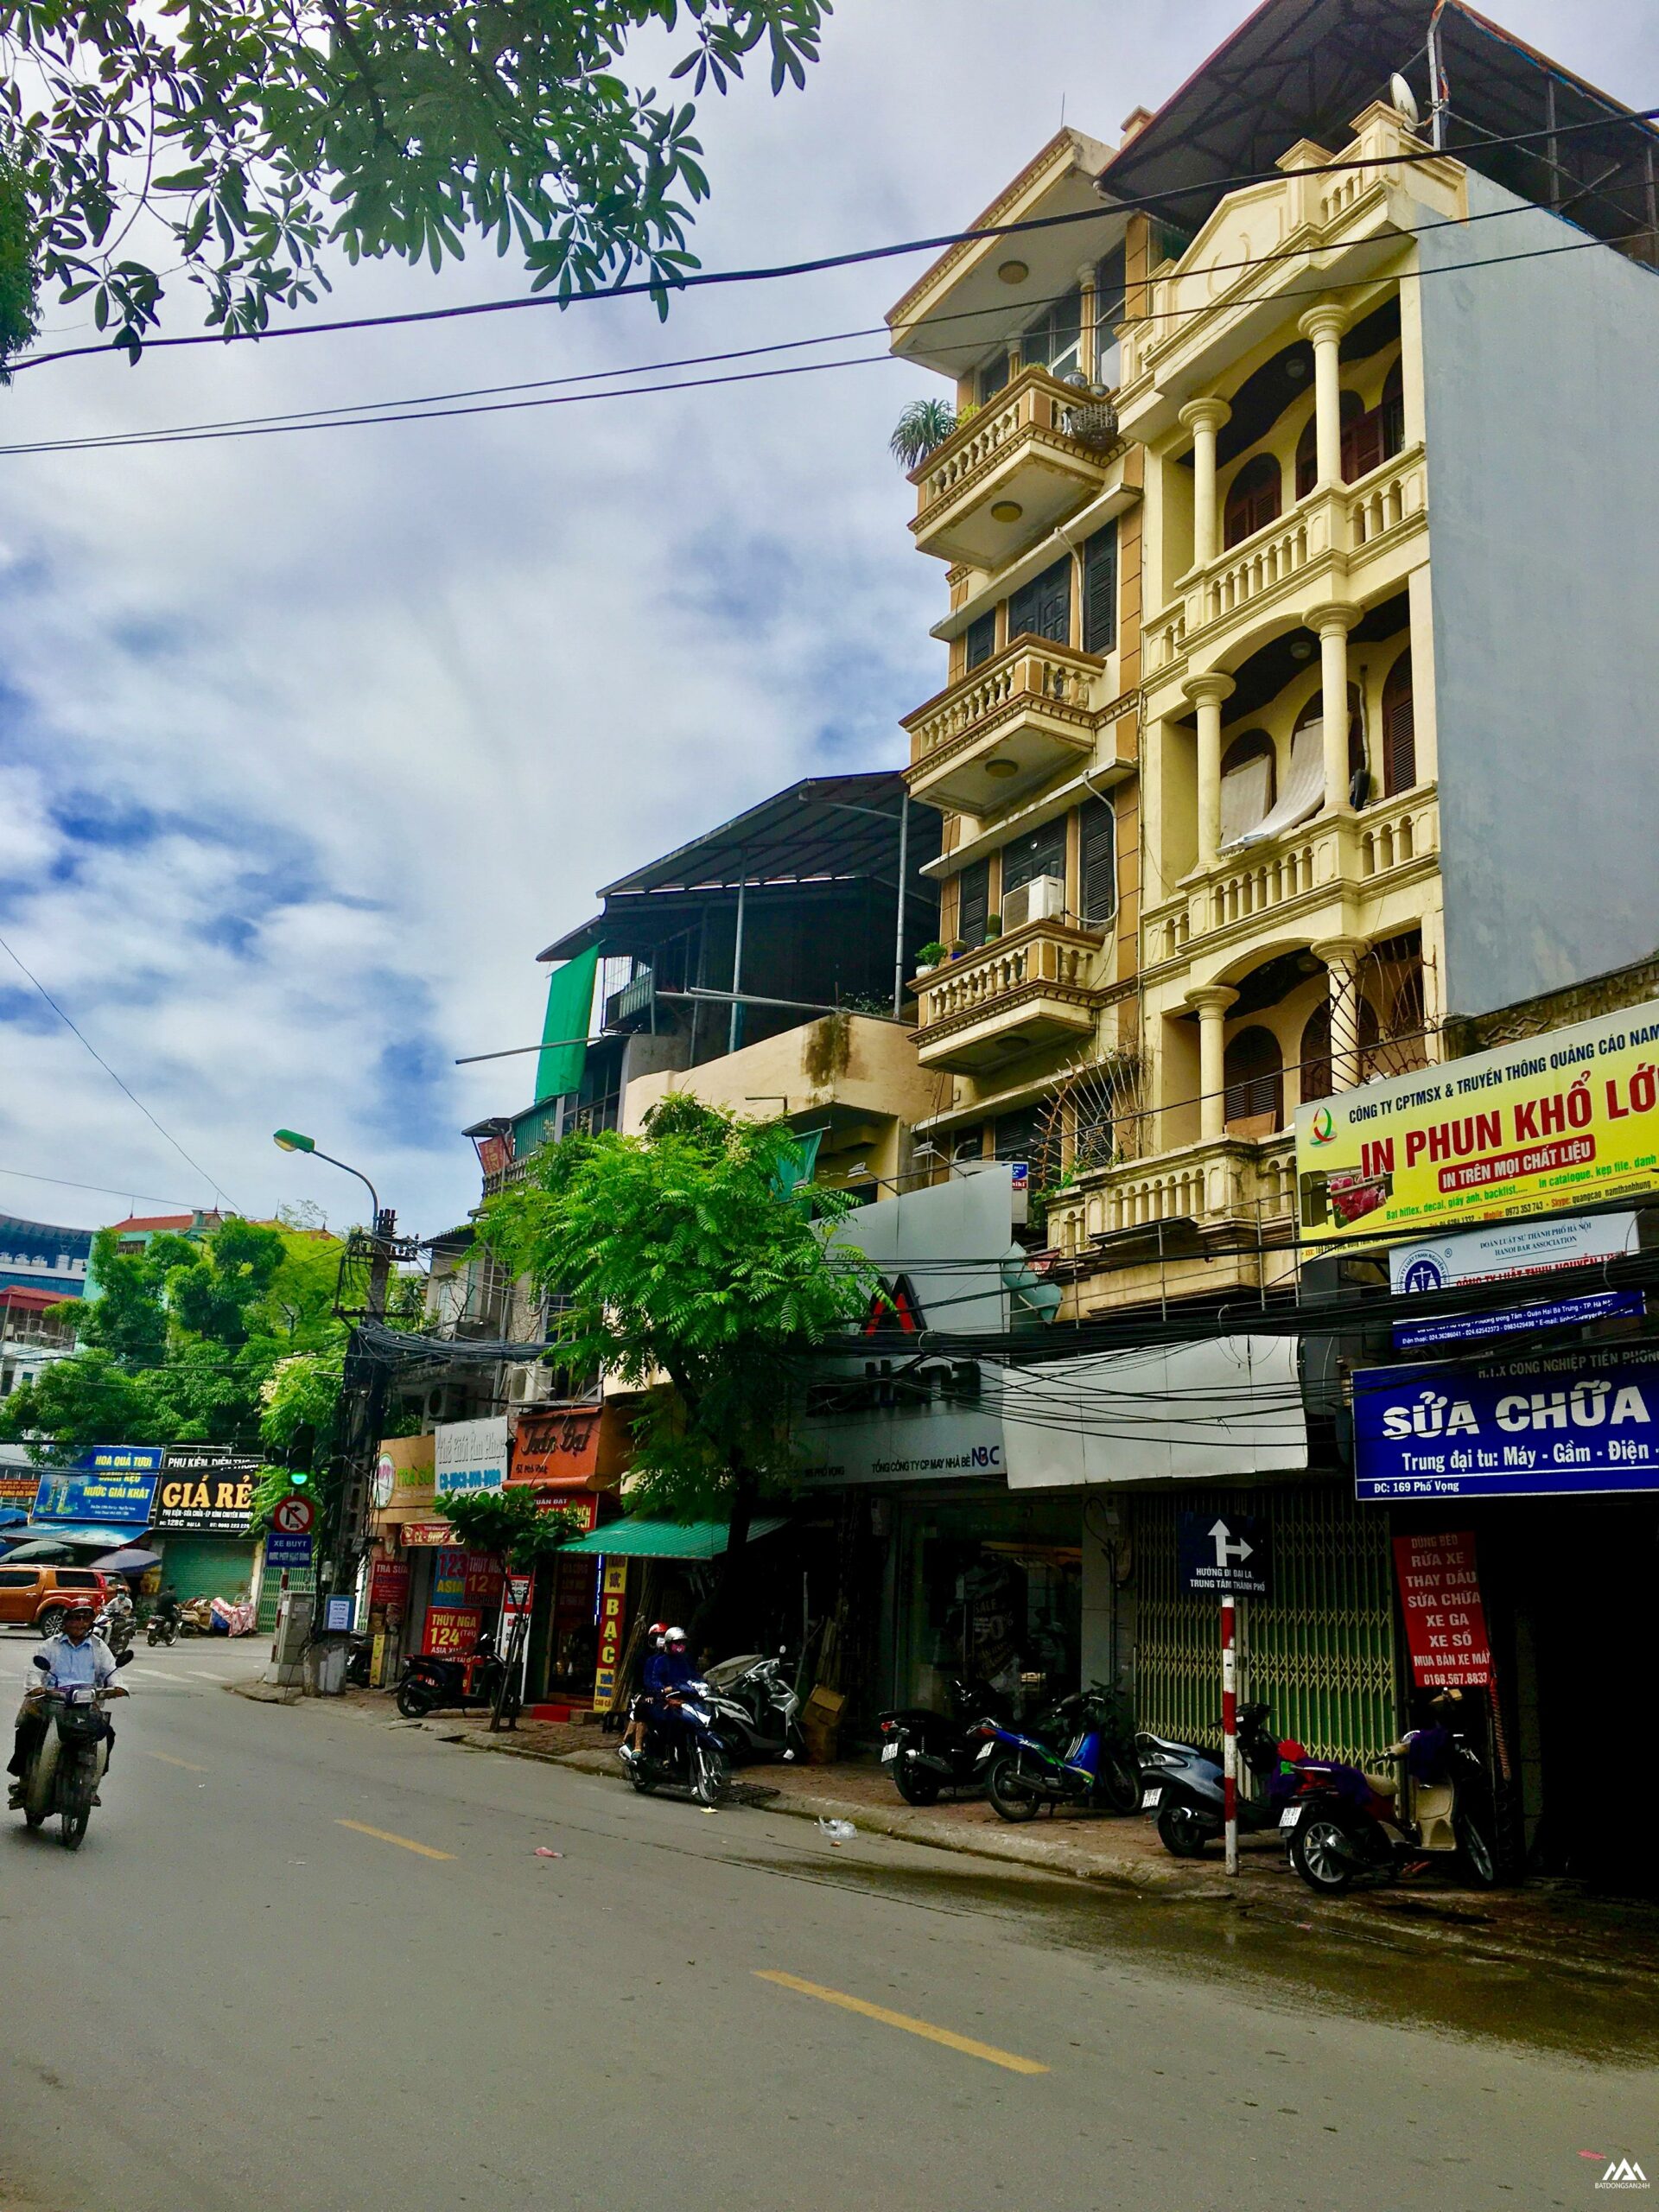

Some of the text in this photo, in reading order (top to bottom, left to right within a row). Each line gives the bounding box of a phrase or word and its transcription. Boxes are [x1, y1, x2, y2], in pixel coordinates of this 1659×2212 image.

[1349, 1104, 1377, 1123] CÔNG
[1380, 1100, 1392, 1115] TY
[1395, 1086, 1441, 1111] CPTMSX
[1445, 1084, 1453, 1097] &
[1505, 1057, 1546, 1080] THÔNG
[1550, 1043, 1594, 1070] QUẢNG
[1599, 1032, 1625, 1055] CÁO
[1361, 1062, 1659, 1179] IN PHUN KHỔ LỚ
[1442, 1141, 1591, 1189] IN TRÊN MỌI CHẤT LIỆU
[1634, 1154, 1656, 1167] danh
[1495, 1246, 1516, 1256] HANOI
[1532, 1236, 1577, 1249] ASSOCIATION
[1382, 1381, 1650, 1440] SỬA CHỮA
[95, 1455, 111, 1466] HOA
[931, 1459, 944, 1470] MAY
[971, 1446, 1000, 1467] NBC
[1402, 1452, 1445, 1472] Trung
[1451, 1449, 1472, 1471] đại
[1477, 1450, 1498, 1467] tu:
[1503, 1445, 1535, 1468] Máy
[1553, 1440, 1591, 1463] Gầm
[1608, 1439, 1649, 1465] Điện
[162, 1474, 253, 1509] GIÁ RẺ
[1374, 1480, 1459, 1494] ĐC: 169 Phố Vọng
[1411, 1551, 1465, 1567] RỬA XE
[1196, 1566, 1223, 1577] HƯỚNG
[1405, 1574, 1441, 1587] THAY
[1190, 1578, 1266, 1592] TRUNG TÂM THÀNH PHỐ
[1408, 1590, 1481, 1608] SỬA CHỮA
[457, 1615, 476, 1628] NGA
[1426, 1613, 1469, 1628] XE GA
[431, 1628, 460, 1646] 124
[1429, 1629, 1472, 1648] XE SỐ
[1414, 1656, 1434, 1667] MUA
[1436, 1652, 1456, 1666] BÁN
[1458, 1654, 1470, 1665] XE
